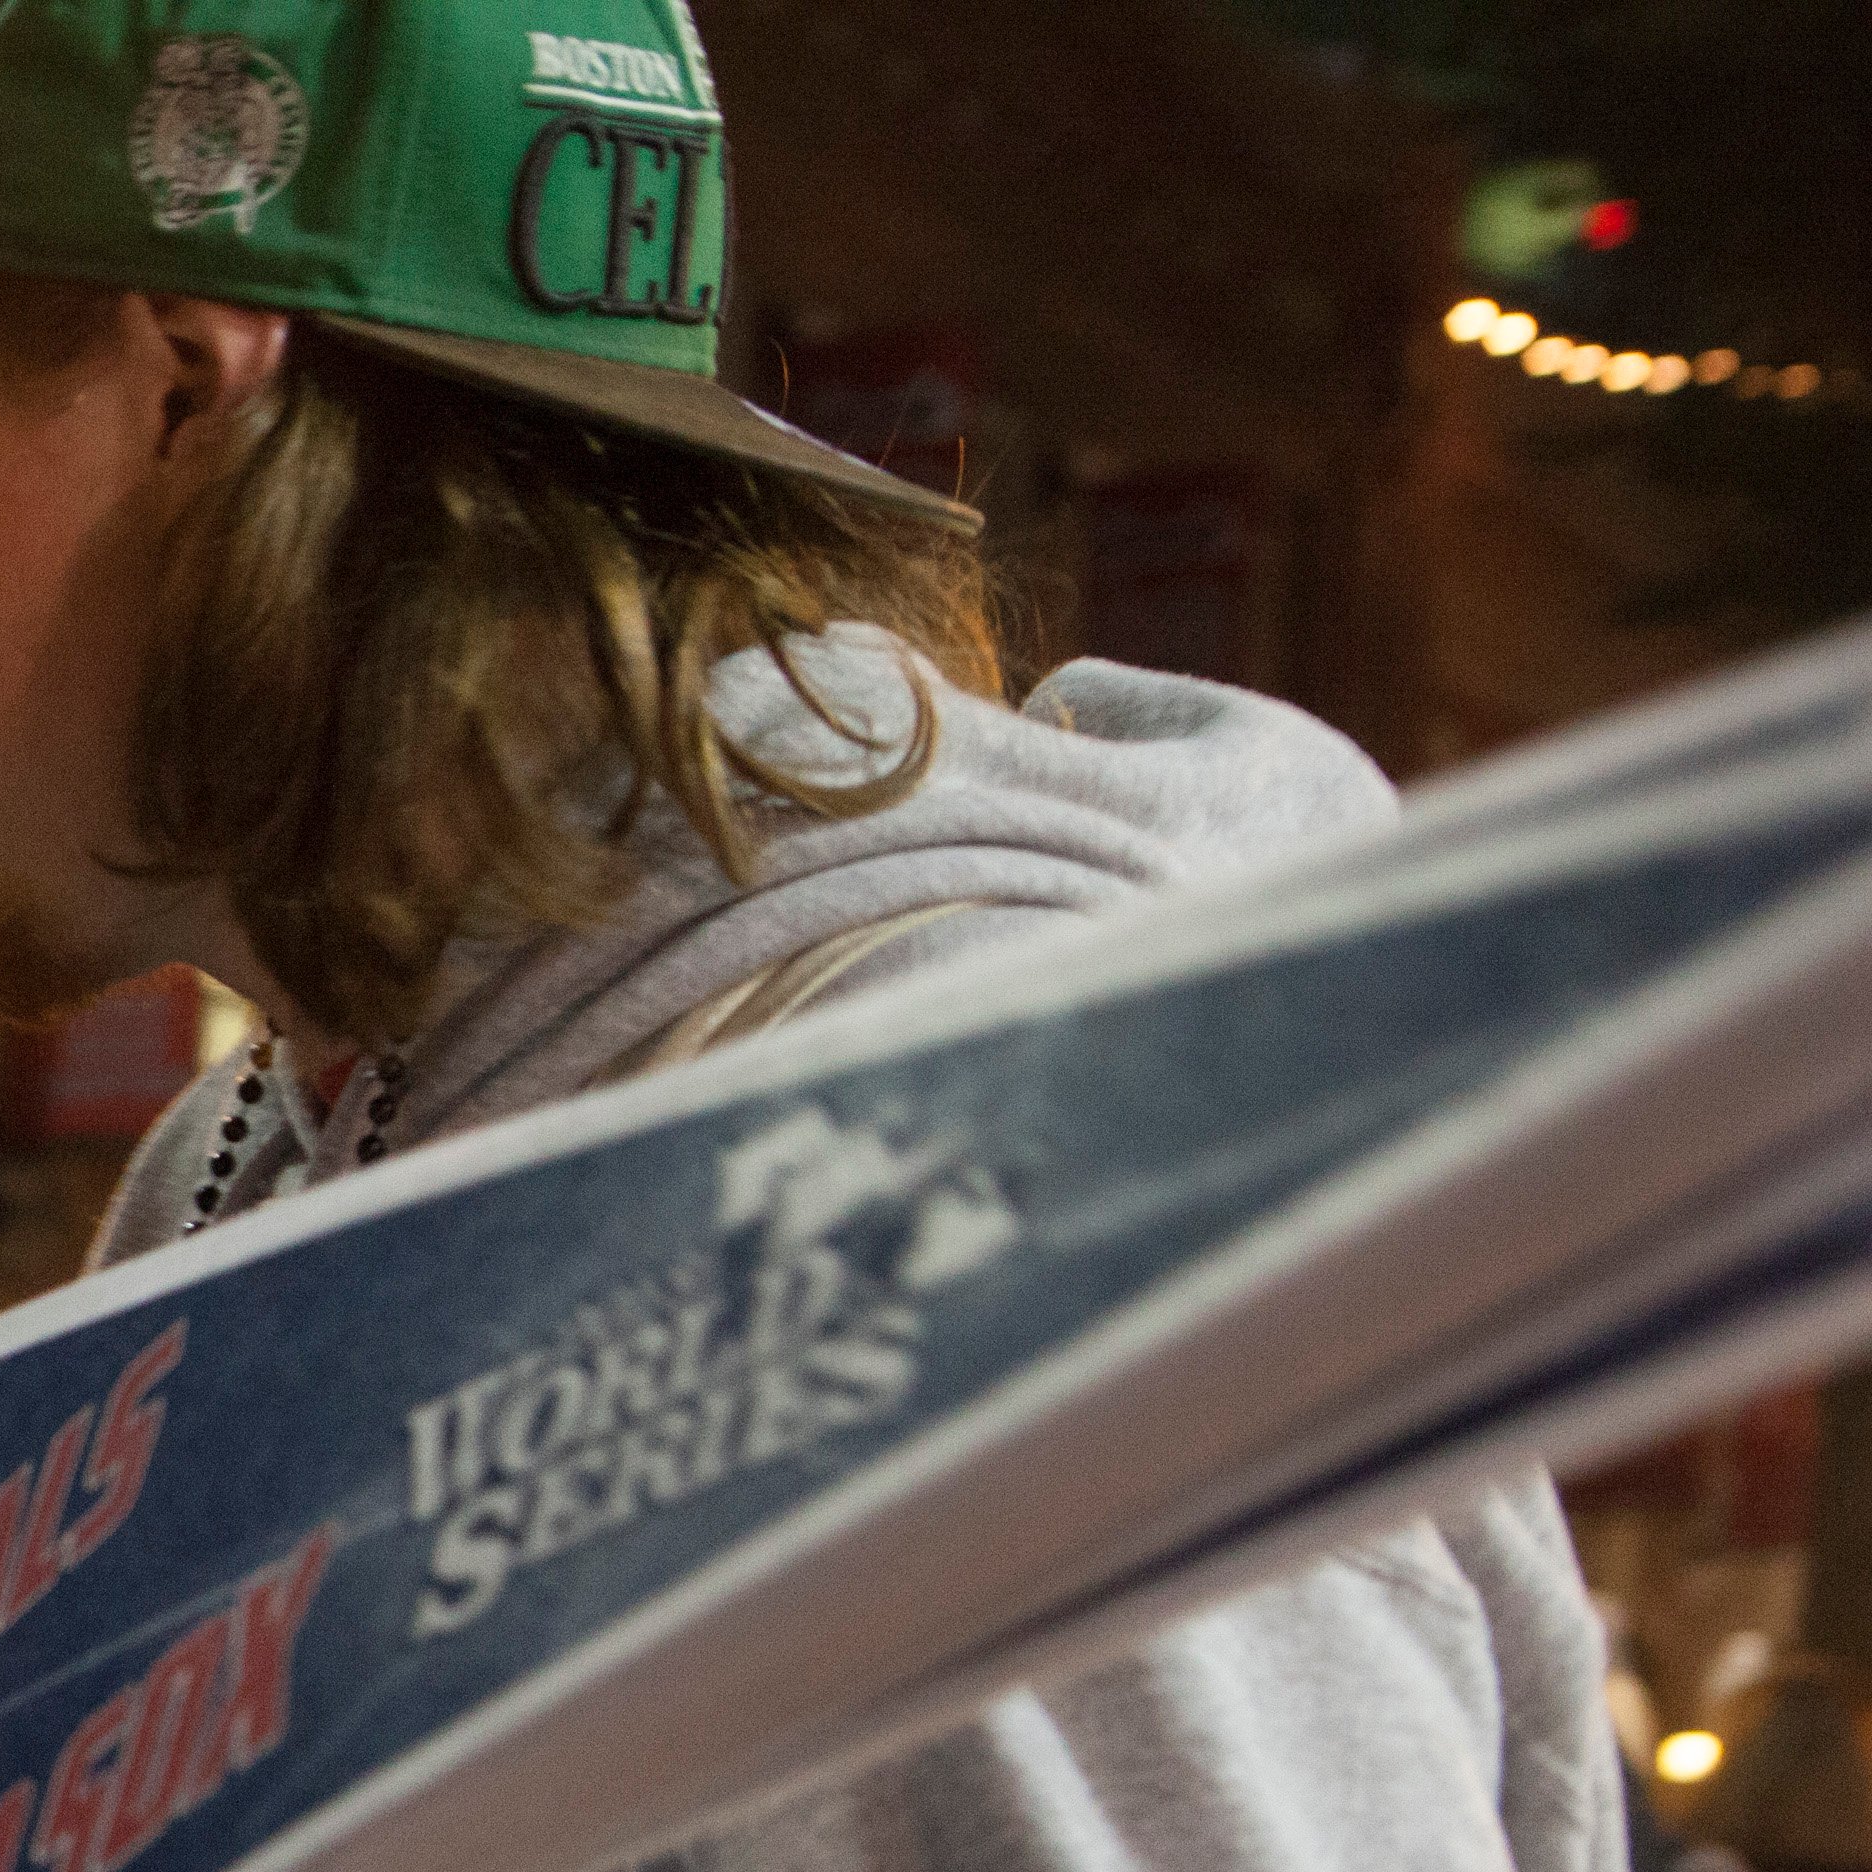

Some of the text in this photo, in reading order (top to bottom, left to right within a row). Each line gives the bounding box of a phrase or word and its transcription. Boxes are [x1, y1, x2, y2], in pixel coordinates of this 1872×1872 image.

[526, 31, 684, 102] BOSTON
[508, 112, 734, 326] CEL
[406, 1243, 848, 1522] WORLD
[411, 1305, 924, 1640] SERIES
